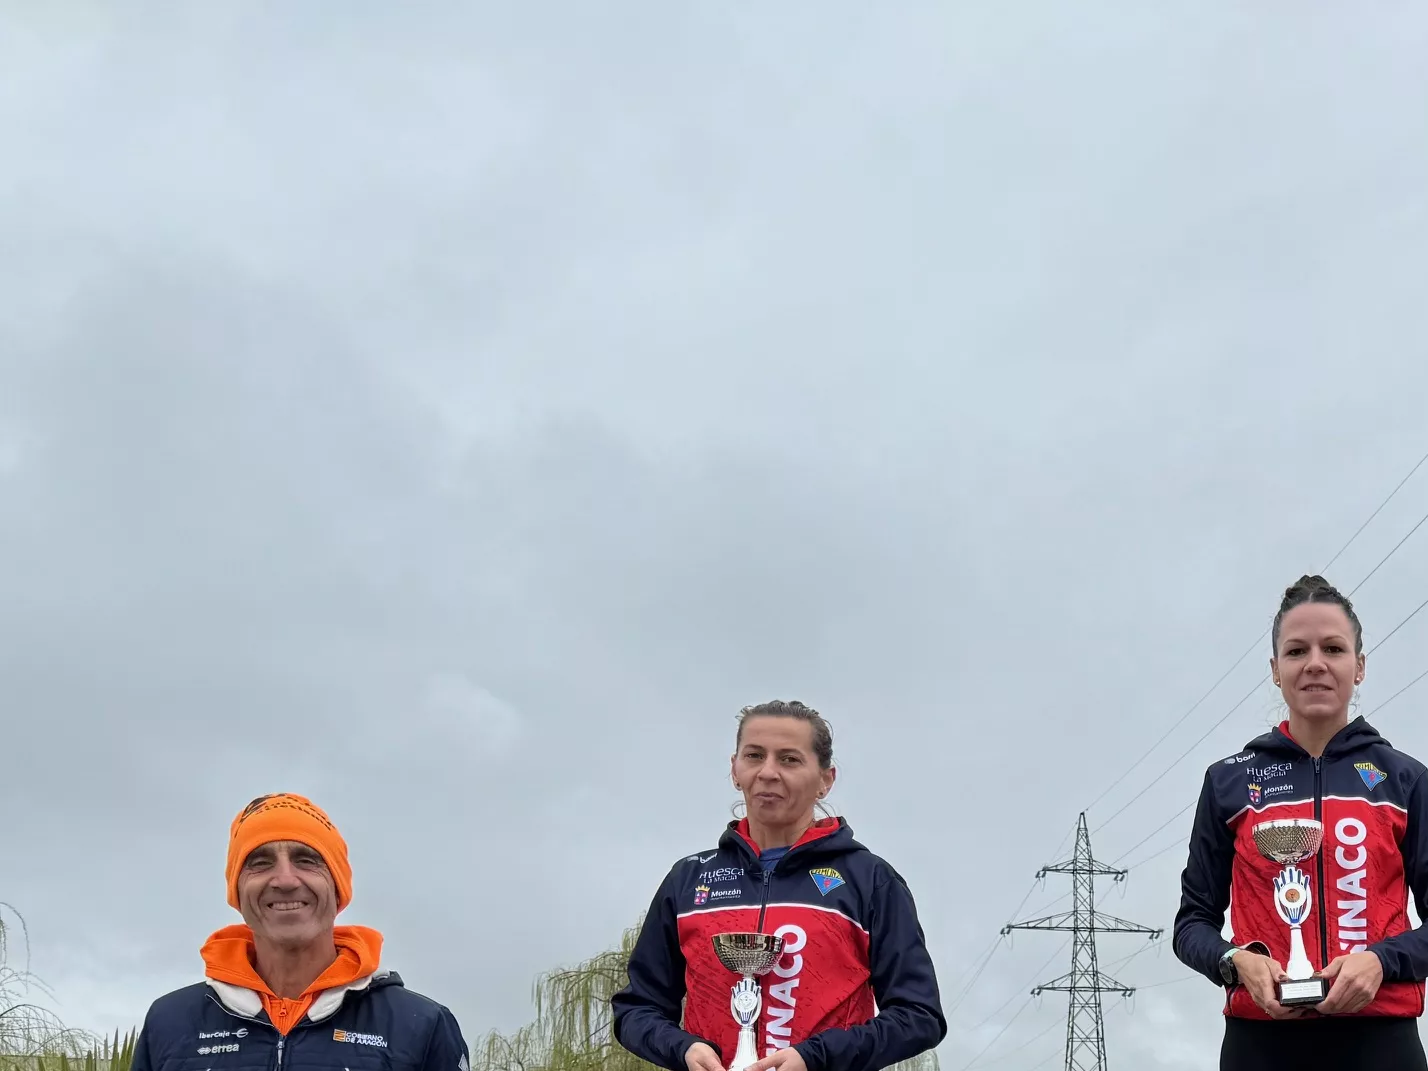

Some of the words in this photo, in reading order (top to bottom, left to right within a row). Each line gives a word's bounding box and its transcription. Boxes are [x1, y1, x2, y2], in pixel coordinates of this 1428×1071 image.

[1246, 762, 1293, 777] Huesca
[1264, 784, 1294, 796] Monzón
[699, 867, 744, 880] Huesca
[711, 889, 742, 898] Monzón
[211, 1043, 240, 1054] errea
